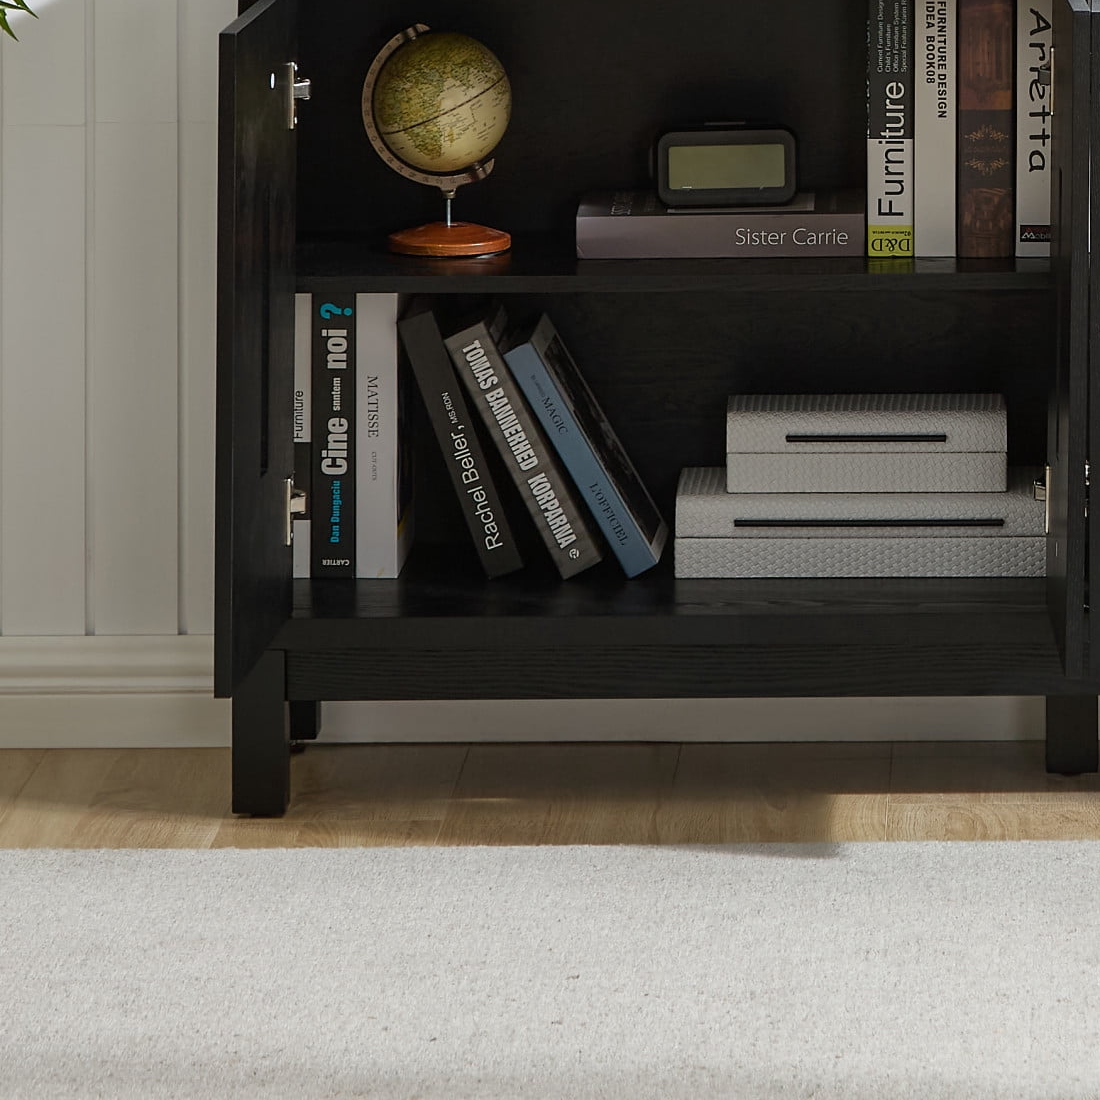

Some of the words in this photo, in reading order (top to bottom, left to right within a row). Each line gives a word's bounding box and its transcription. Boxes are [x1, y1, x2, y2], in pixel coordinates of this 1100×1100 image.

[876, 0, 885, 20] Design
[925, 0, 935, 32] IDEA
[876, 21, 884, 49] Furniture
[937, 0, 947, 71] FURNITURE
[937, 73, 947, 119] DESIGN
[878, 81, 905, 217] Furniture
[734, 228, 789, 245] Sister
[792, 228, 849, 245] Carrie
[871, 238, 912, 252] D&D
[320, 302, 353, 320] ?
[322, 329, 347, 369] noi
[366, 375, 379, 438] MATISSE
[542, 397, 568, 436] MAGIC
[321, 417, 348, 475] Cine
[449, 423, 480, 484] Beller,
[462, 340, 498, 390] TOMAS
[485, 387, 538, 472] BANNERHED
[527, 472, 577, 550] KORPARNA
[329, 480, 342, 523] Dungaciu
[467, 489, 503, 551] Rachel
[588, 482, 628, 547] L'OFFICIEL
[329, 524, 341, 543] Dan
[321, 558, 350, 566] CARTIER
